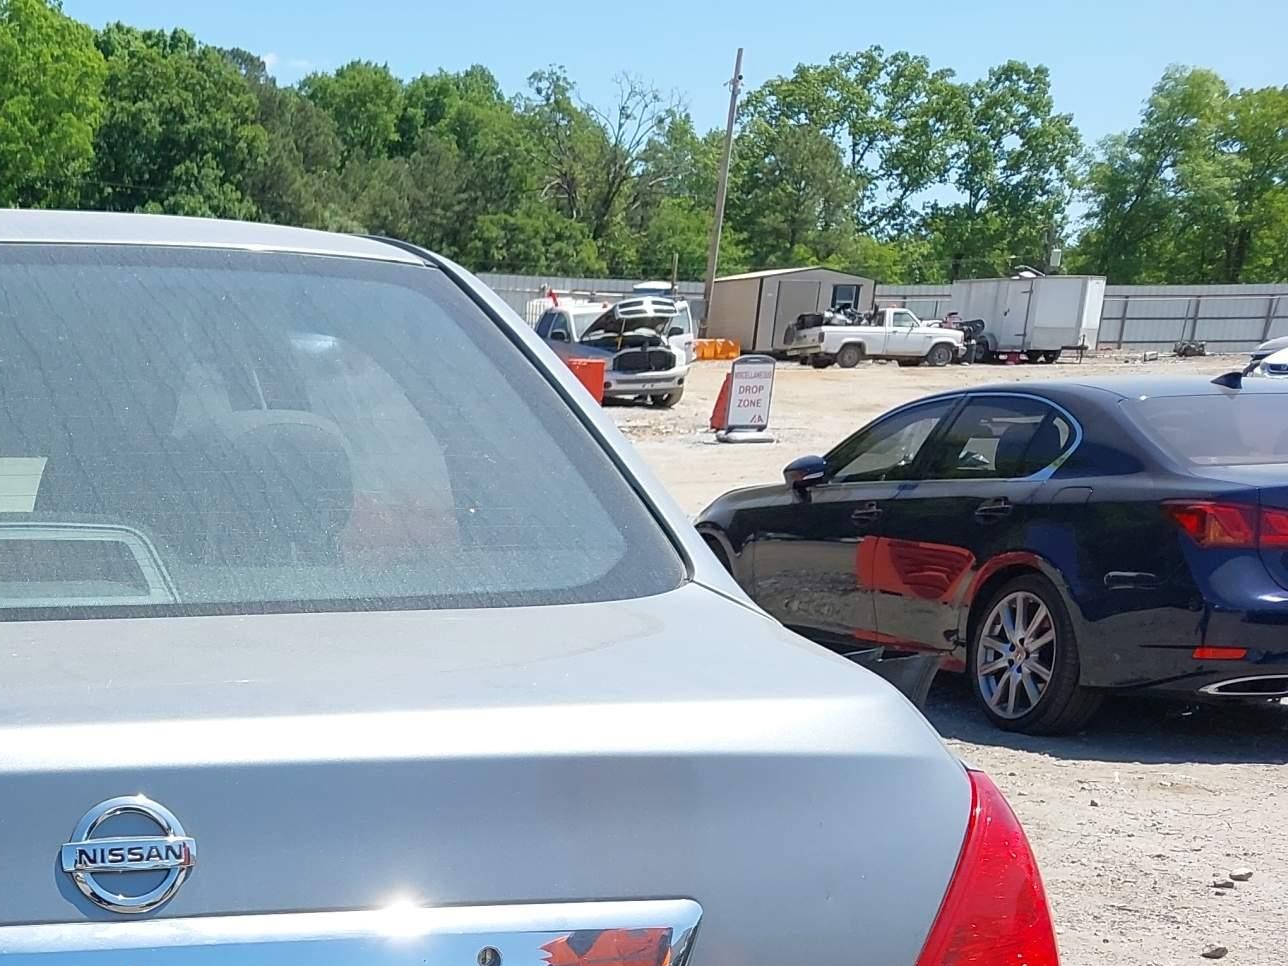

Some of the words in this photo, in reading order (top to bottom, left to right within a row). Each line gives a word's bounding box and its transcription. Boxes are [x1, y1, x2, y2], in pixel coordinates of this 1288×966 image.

[738, 384, 765, 395] DROP
[737, 398, 762, 408] ZONE
[77, 845, 184, 865] NISSAN
